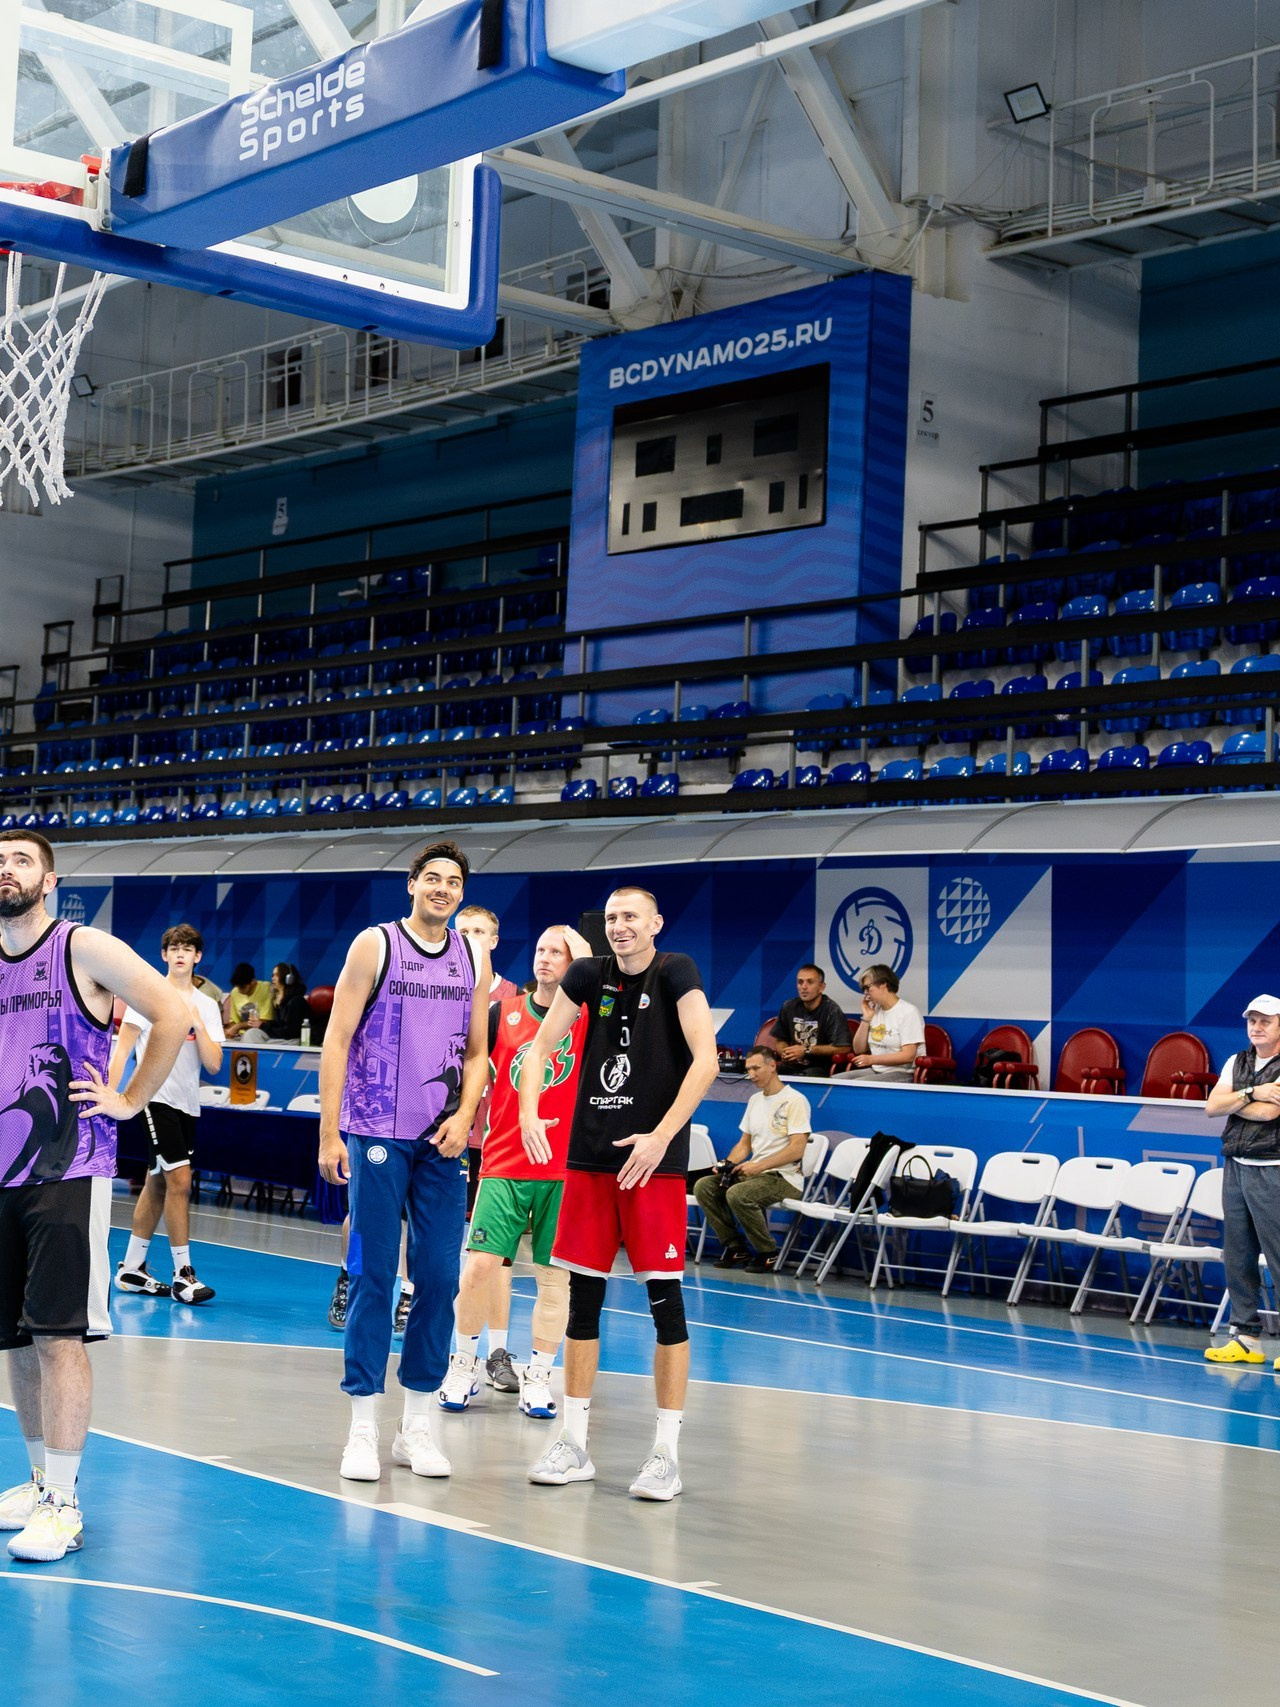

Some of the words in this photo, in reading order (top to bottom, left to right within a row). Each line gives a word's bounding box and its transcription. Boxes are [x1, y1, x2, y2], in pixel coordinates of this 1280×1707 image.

[240, 60, 366, 130] Schelde
[239, 93, 365, 162] Sports
[609, 317, 833, 389] BCDYNAMO25.RU
[922, 400, 934, 423] 5
[400, 961, 425, 972] ЛДПР
[9, 989, 62, 1013] ПРИМОРЬЯ
[389, 980, 428, 999] СОКОЛЫ
[589, 1096, 634, 1105] СПАРТАК
